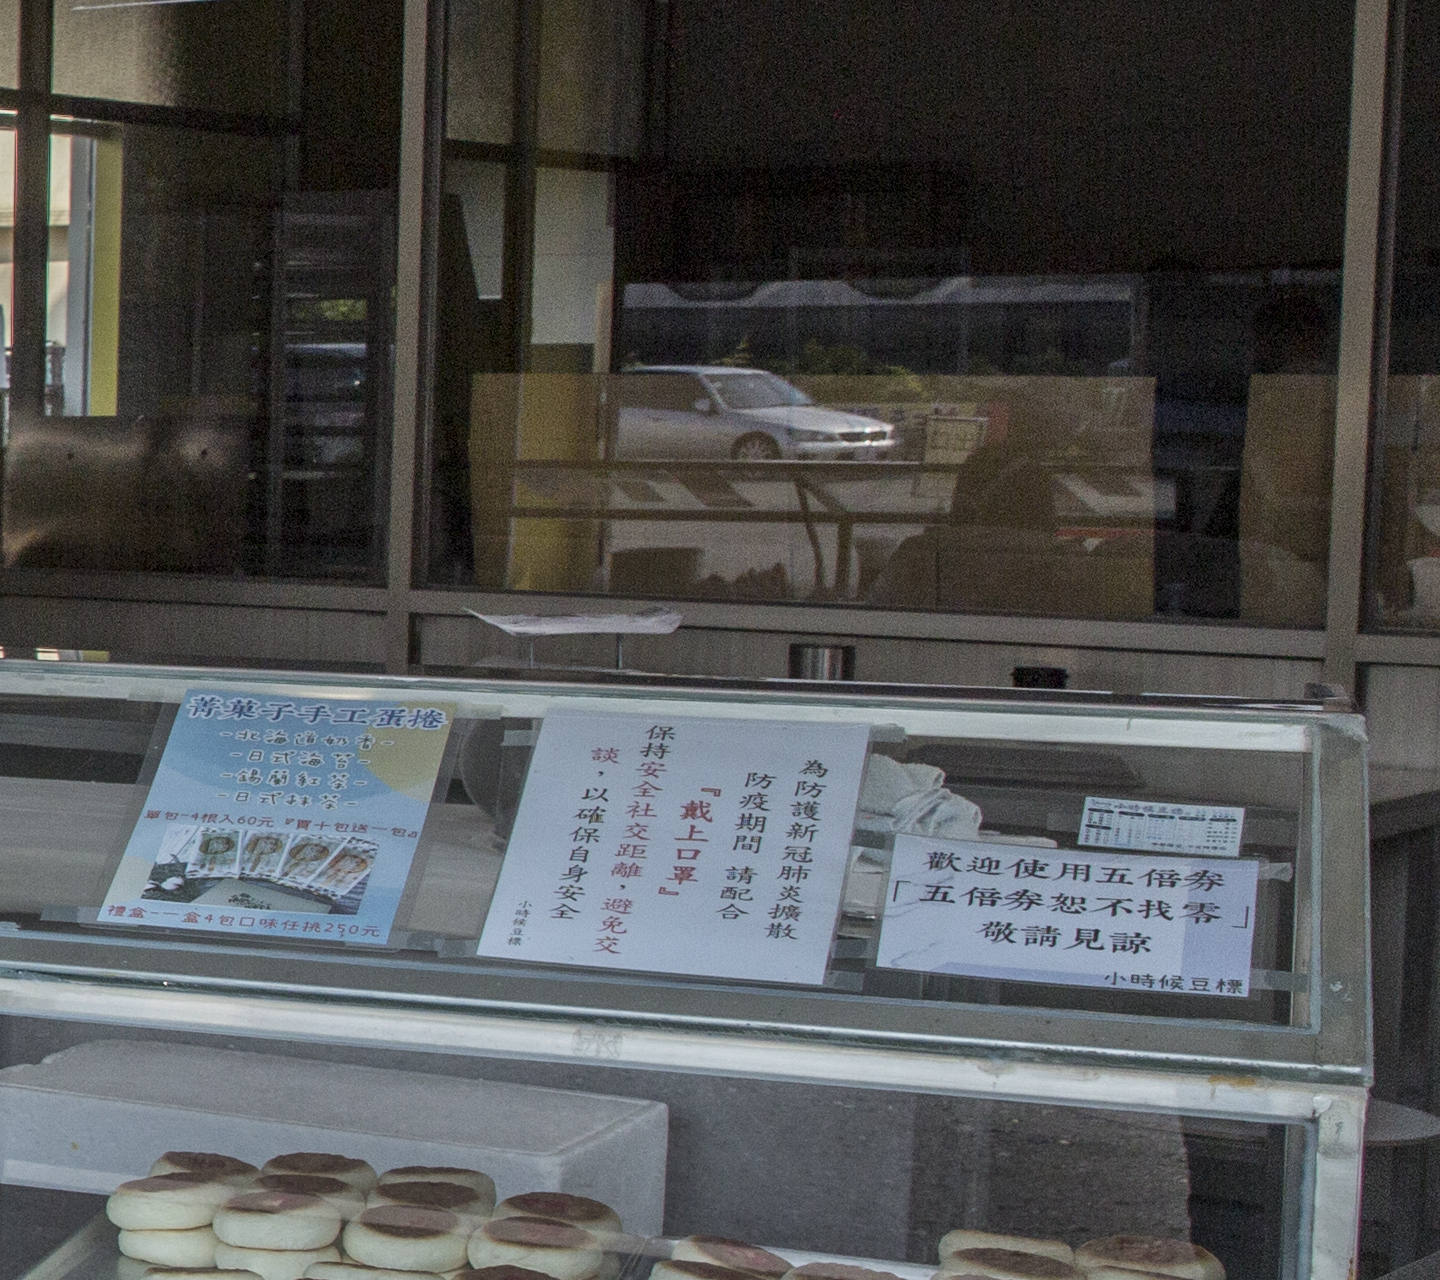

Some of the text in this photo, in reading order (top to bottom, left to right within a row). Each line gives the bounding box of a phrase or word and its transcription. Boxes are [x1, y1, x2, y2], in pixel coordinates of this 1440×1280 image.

[187, 696, 446, 729] 菁菓子手工蛋捲
[717, 773, 777, 920] 防疫期間 請配合
[923, 851, 1224, 892] 歡迎使用五倍券
[976, 921, 1152, 954] 敬請見諒
[1104, 972, 1243, 995] 小時候豆標
